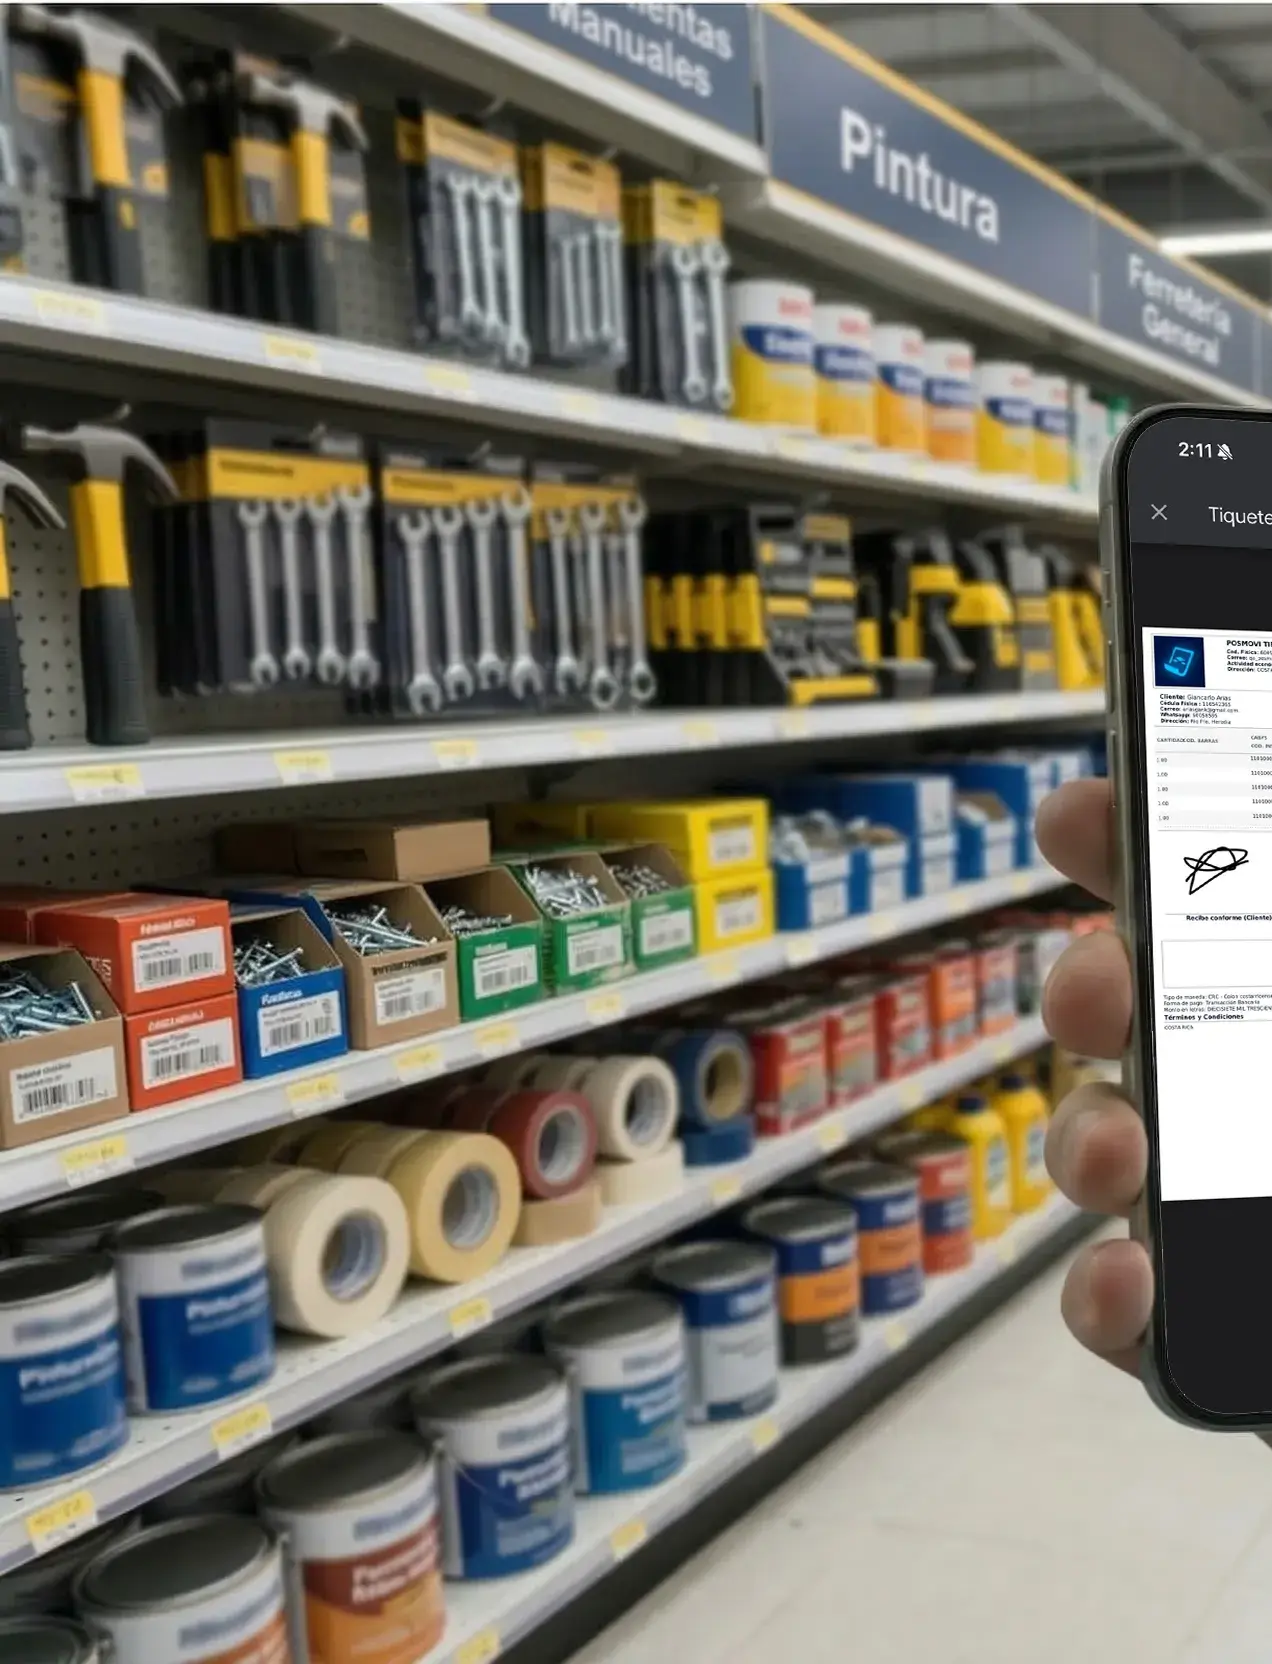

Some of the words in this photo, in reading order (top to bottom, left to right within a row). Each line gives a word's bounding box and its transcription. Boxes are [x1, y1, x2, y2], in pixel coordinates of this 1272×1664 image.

[548, 4, 714, 98] Manuales
[627, 4, 734, 61] entas
[839, 107, 1001, 245] Pintura
[1142, 302, 1220, 367] General
[1178, 442, 1213, 459] 2:11
